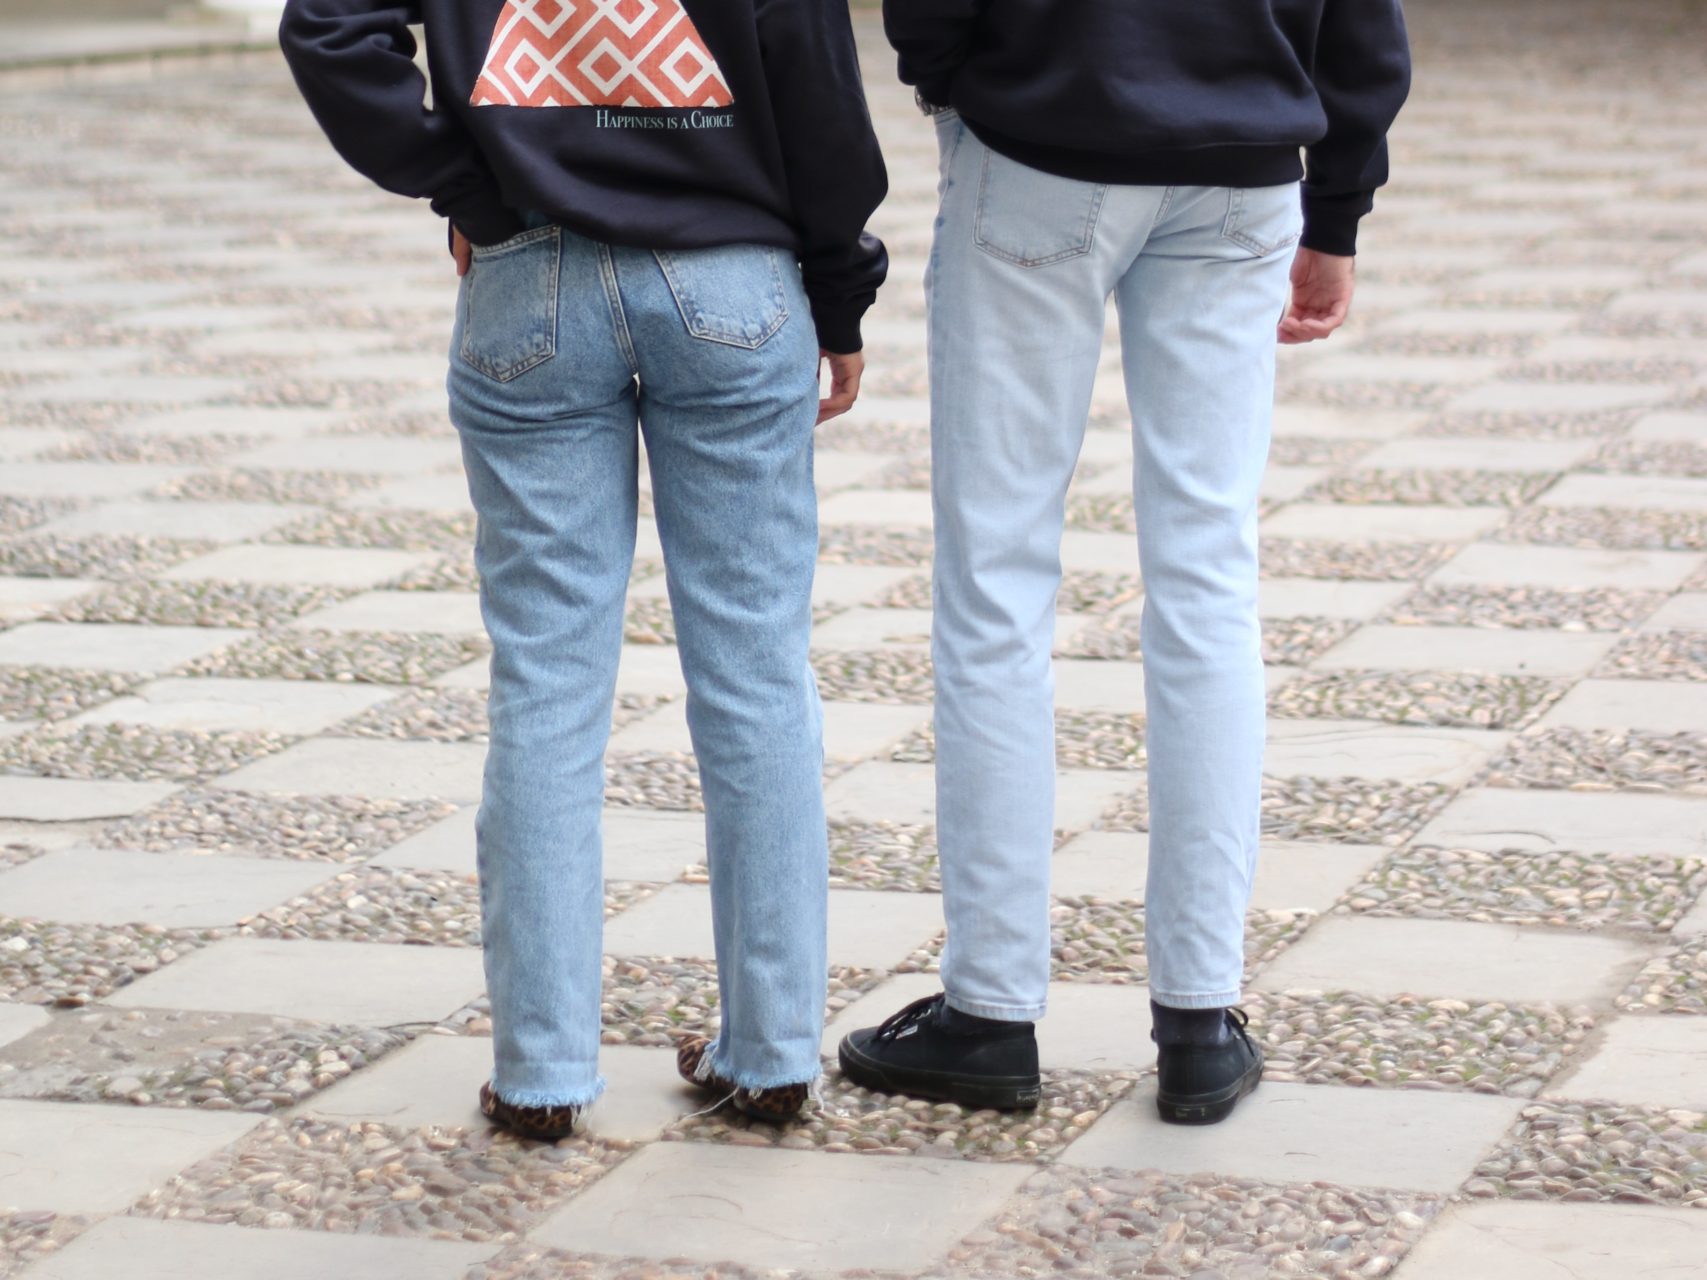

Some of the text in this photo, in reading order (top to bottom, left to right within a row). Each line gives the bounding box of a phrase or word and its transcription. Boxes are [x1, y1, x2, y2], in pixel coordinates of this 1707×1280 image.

[595, 109, 734, 129] HAPPINESS IS A CHOICE
